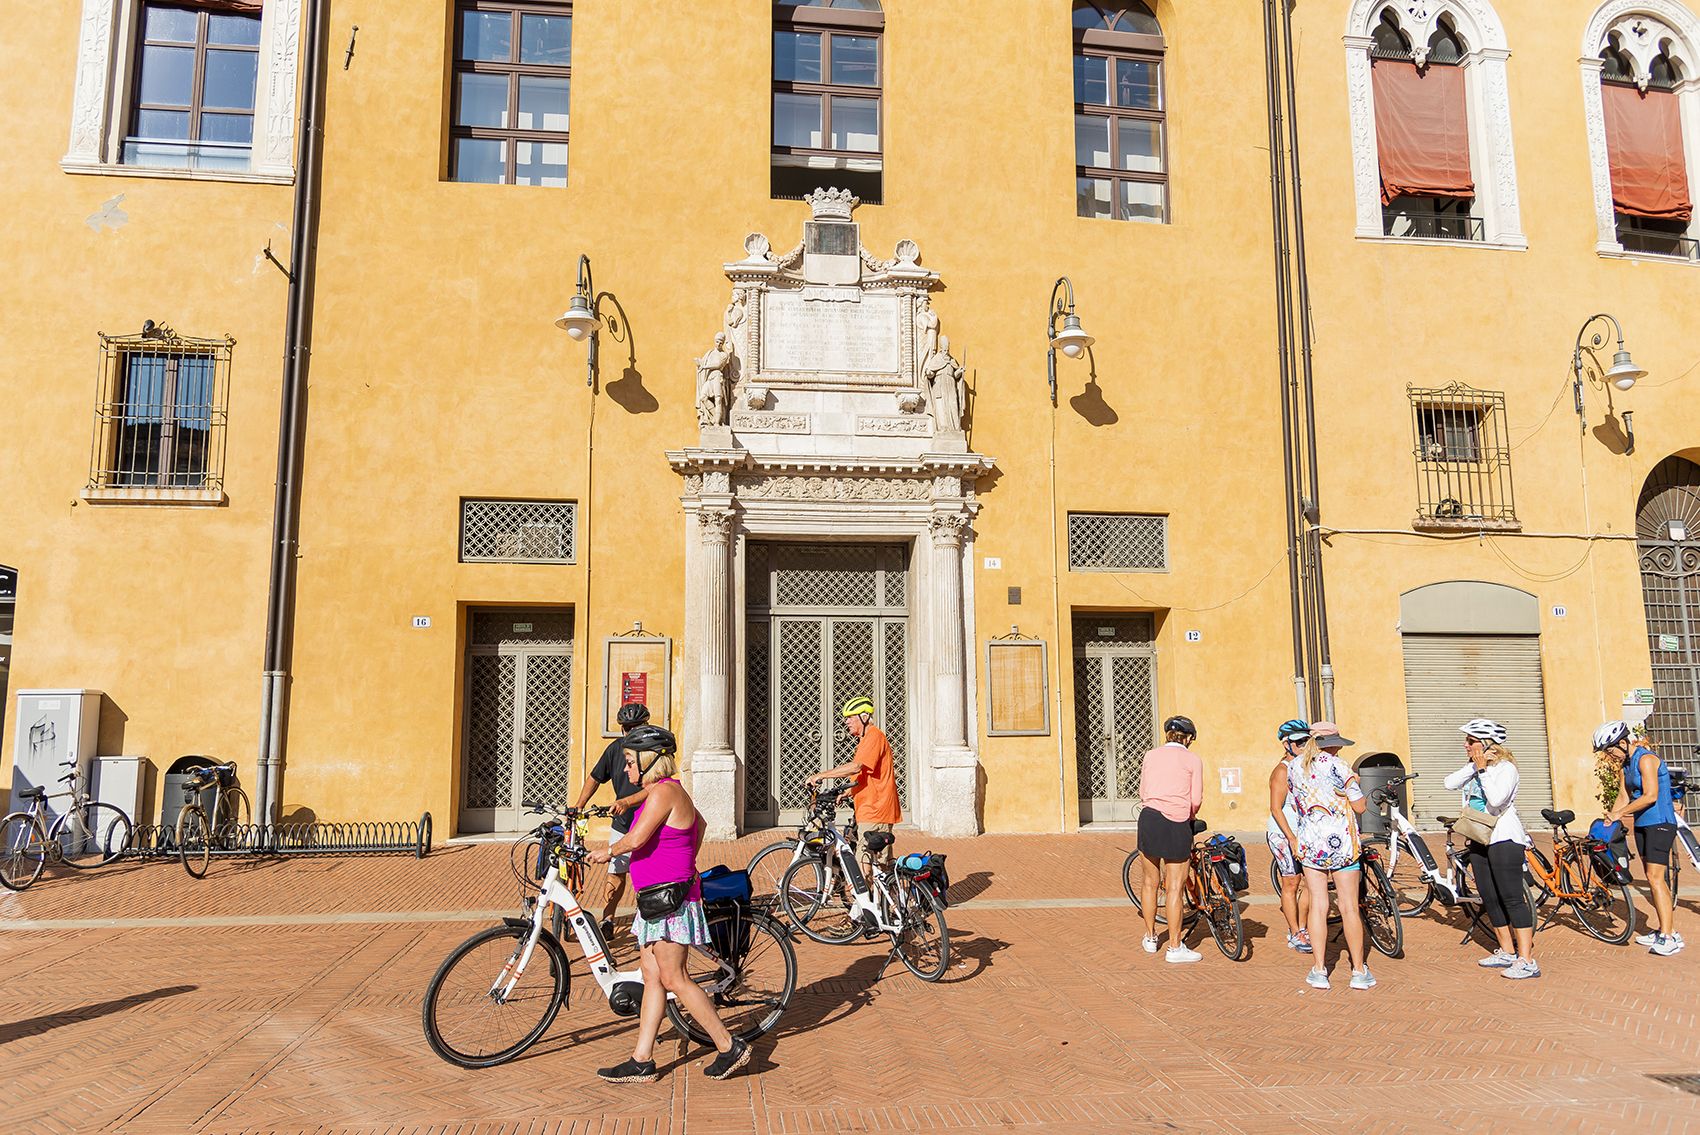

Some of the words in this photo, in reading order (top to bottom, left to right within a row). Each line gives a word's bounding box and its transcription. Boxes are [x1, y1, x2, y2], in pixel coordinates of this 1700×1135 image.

[988, 559, 997, 568] 14
[1554, 607, 1565, 616] 10
[416, 618, 427, 626] 16
[1188, 631, 1199, 641] 12
